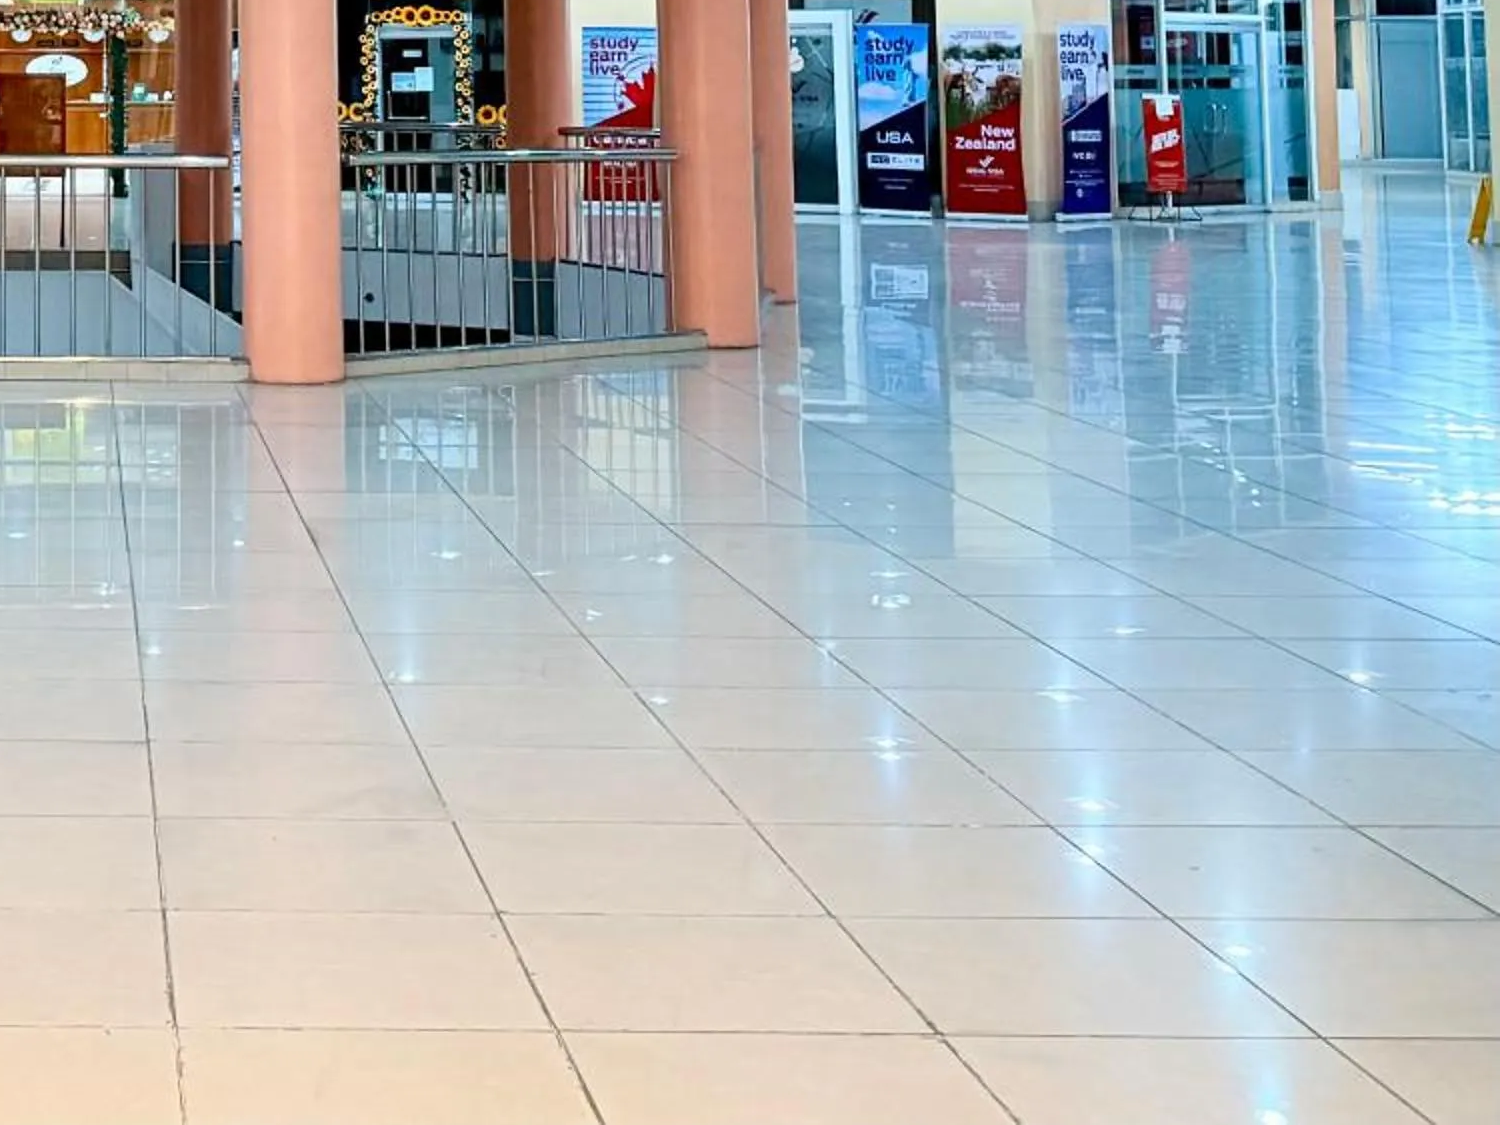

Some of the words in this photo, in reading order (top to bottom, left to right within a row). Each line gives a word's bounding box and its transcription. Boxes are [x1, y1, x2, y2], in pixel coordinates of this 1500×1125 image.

[589, 36, 639, 51] study
[865, 36, 915, 55] study
[1060, 30, 1095, 50] study
[589, 50, 628, 62] earn
[865, 53, 905, 65] earn
[1060, 50, 1089, 63] earn
[589, 61, 621, 75] live
[865, 65, 897, 81] live
[1061, 64, 1084, 81] live
[876, 130, 915, 144] USA
[981, 124, 1015, 137] New
[954, 136, 1016, 151] Zealand
